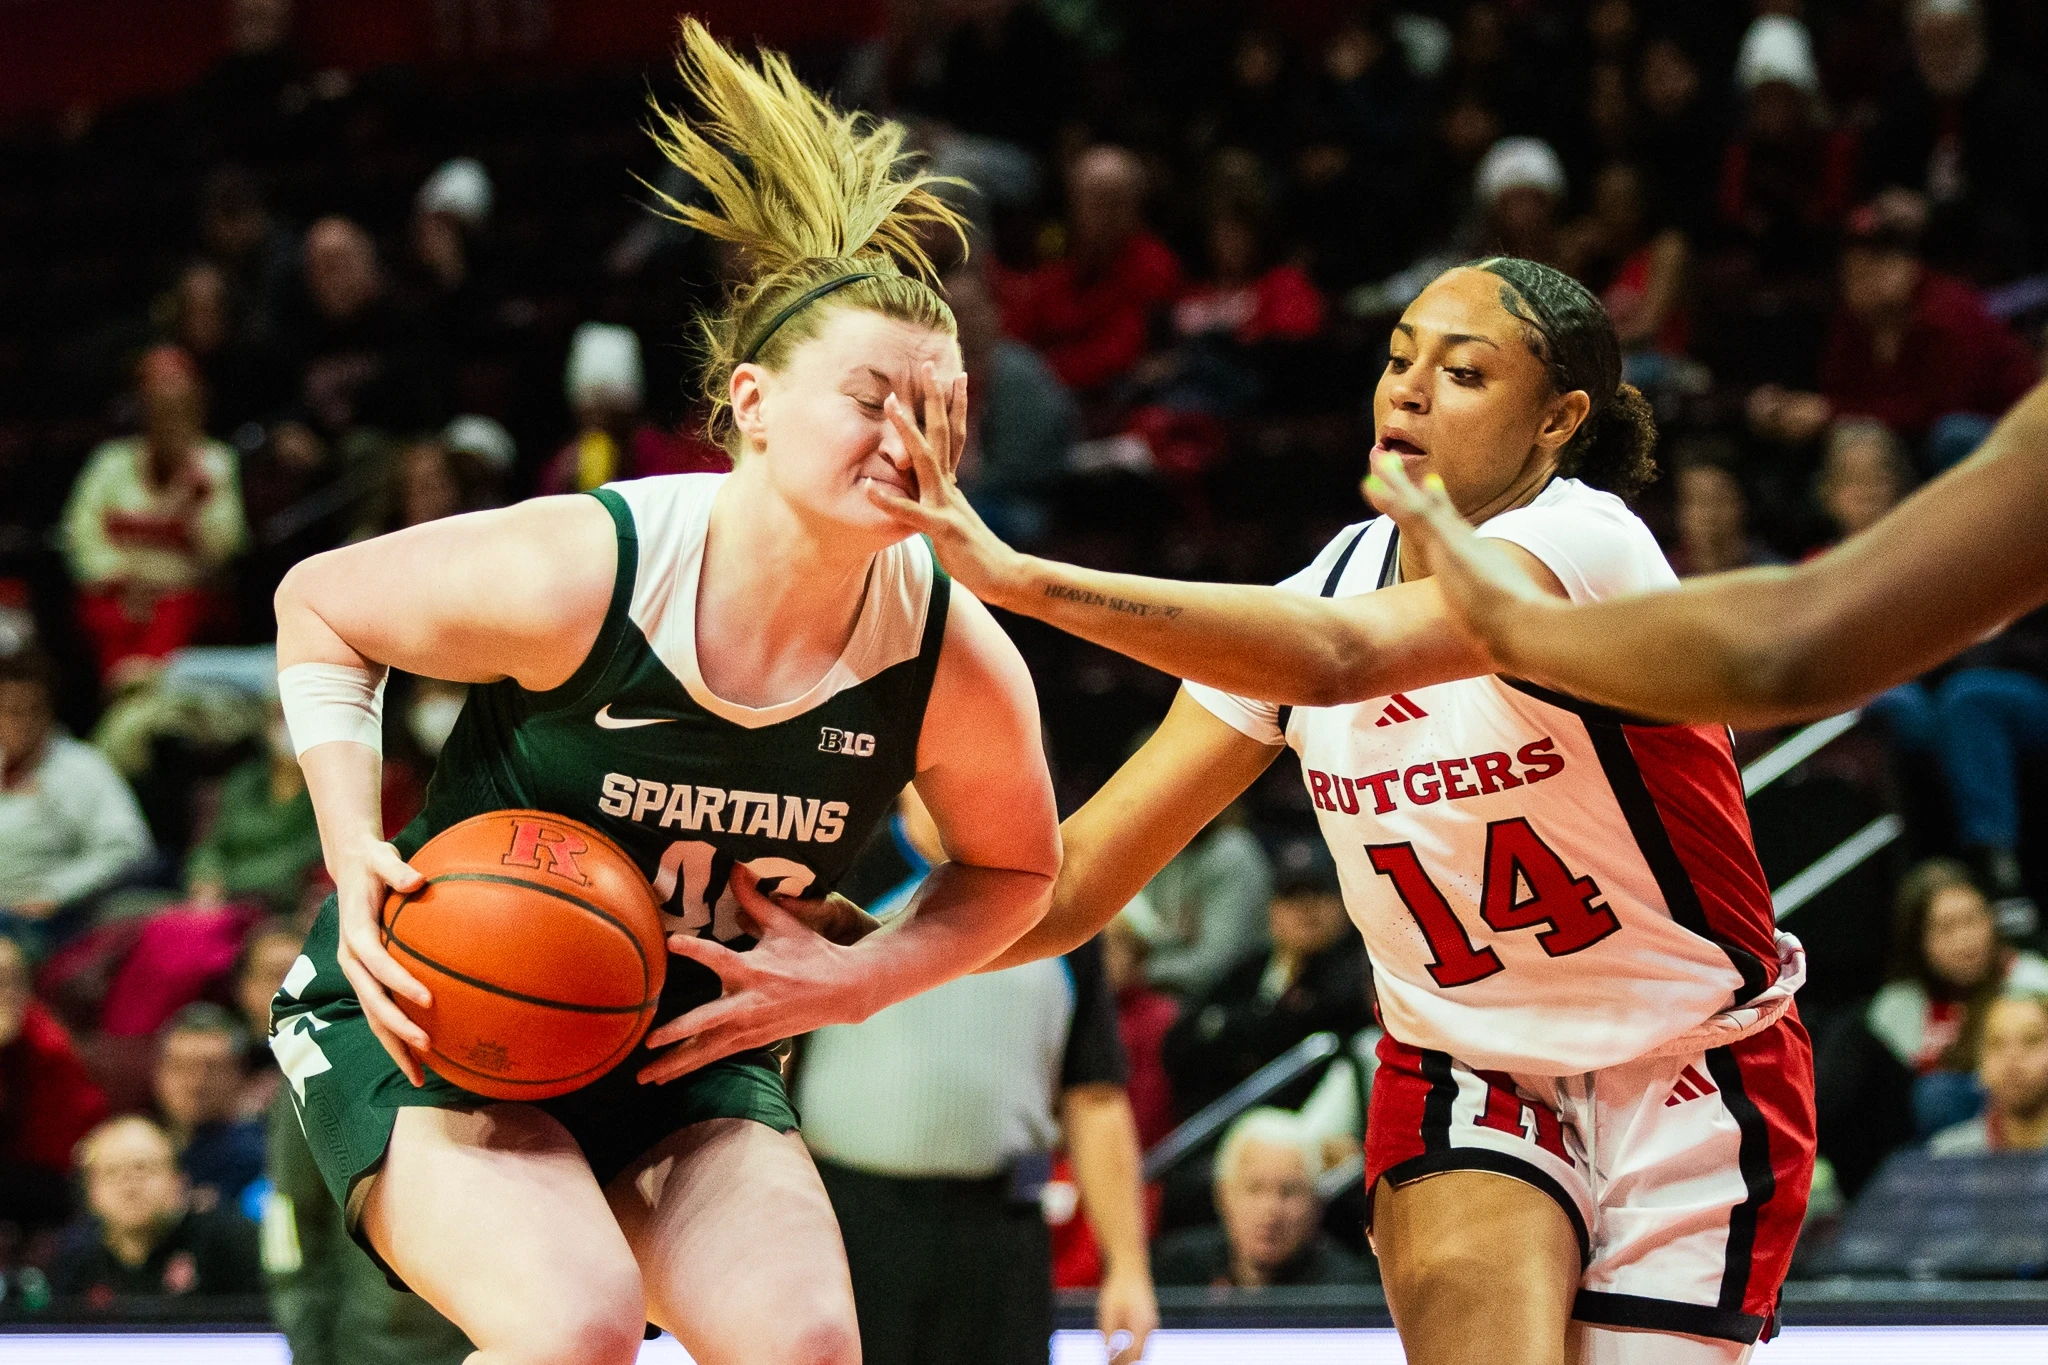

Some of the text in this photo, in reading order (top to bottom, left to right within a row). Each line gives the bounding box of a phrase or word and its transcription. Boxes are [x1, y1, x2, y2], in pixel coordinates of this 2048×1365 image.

[1044, 584, 1107, 607] HEAVEN
[598, 772, 850, 843] SPARTANS
[1308, 736, 1565, 815] RUTGERS
[501, 820, 589, 887] R
[1363, 816, 1623, 988] 14
